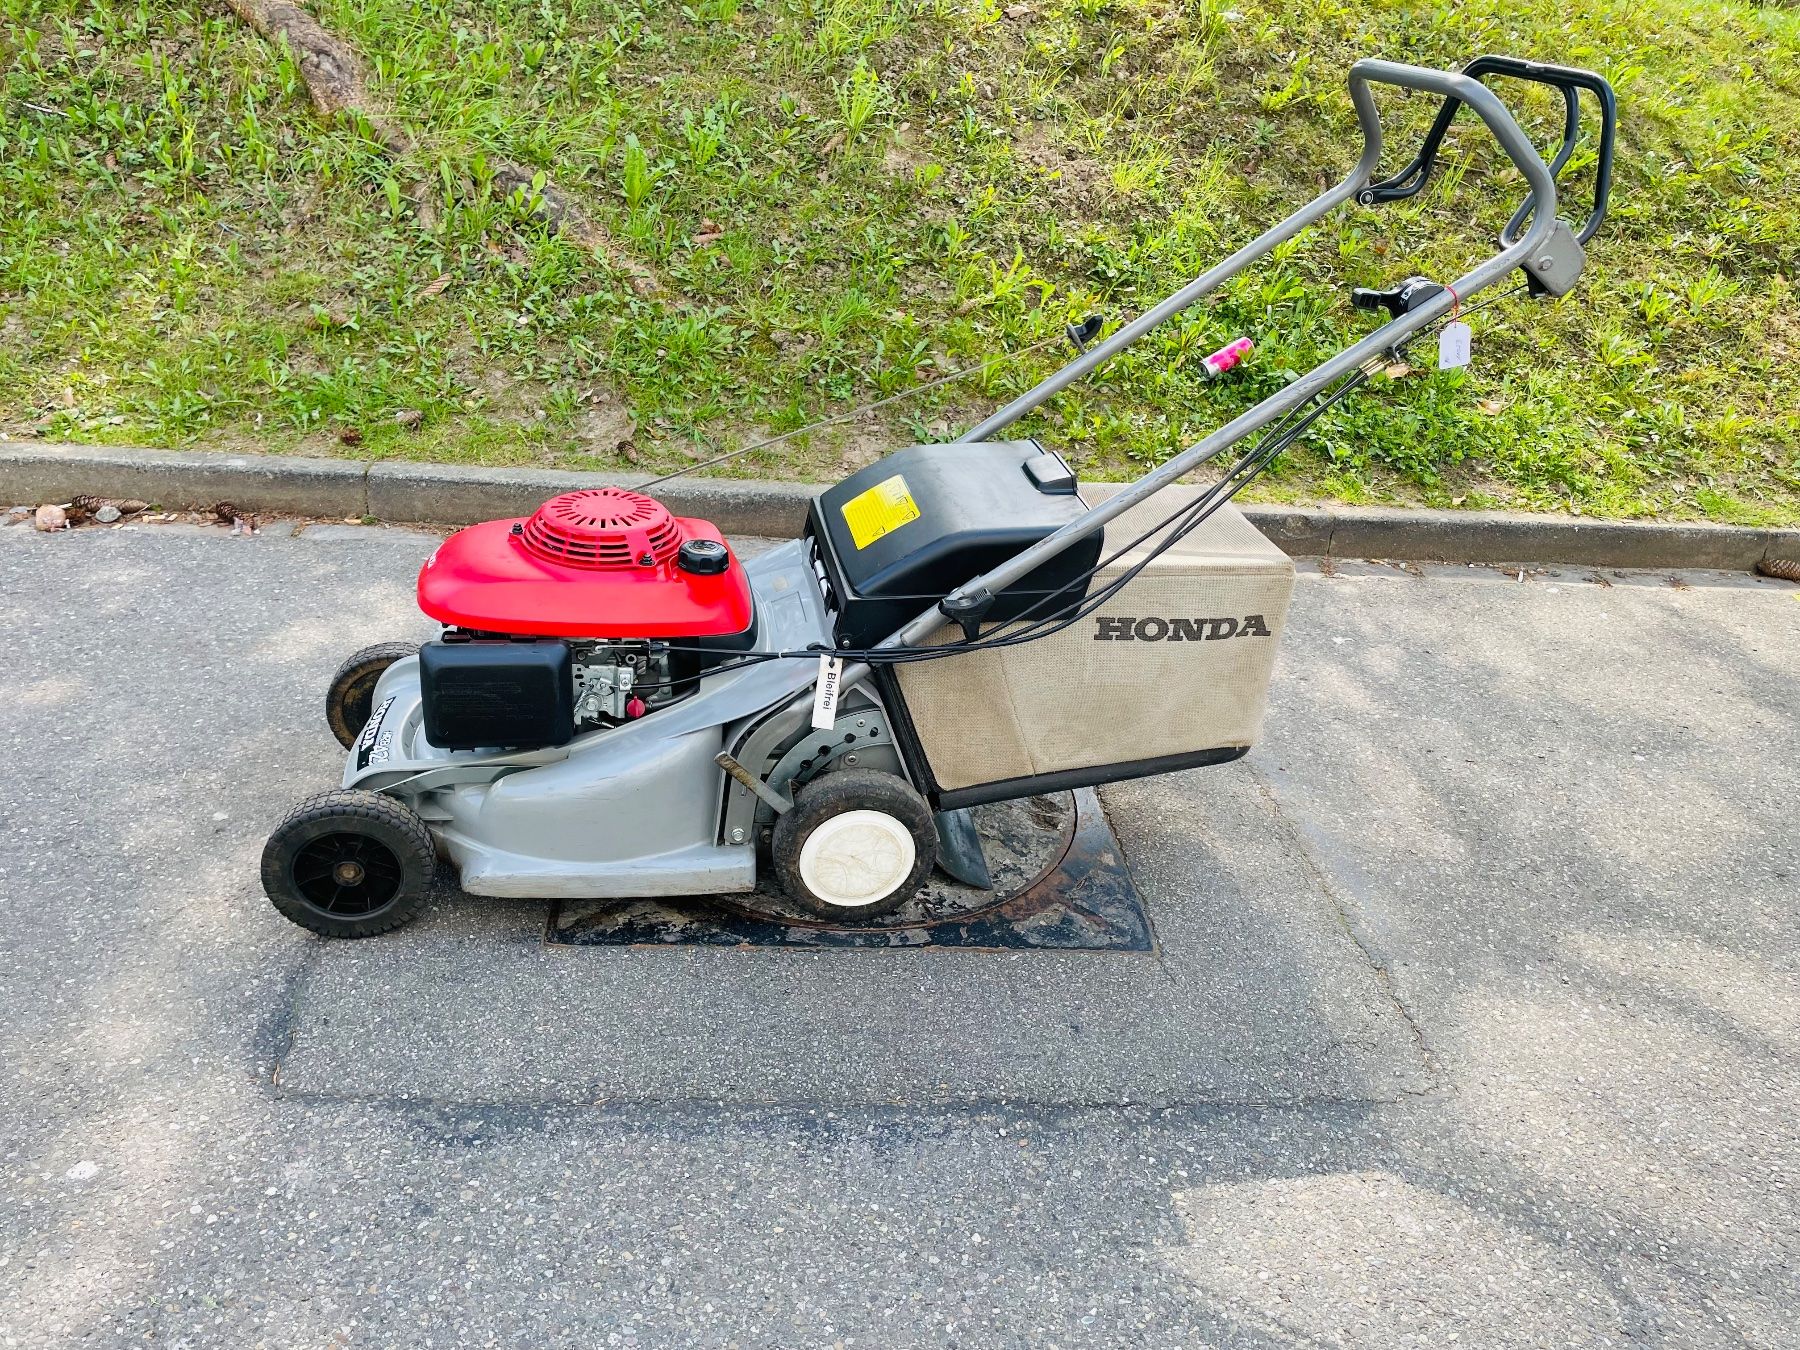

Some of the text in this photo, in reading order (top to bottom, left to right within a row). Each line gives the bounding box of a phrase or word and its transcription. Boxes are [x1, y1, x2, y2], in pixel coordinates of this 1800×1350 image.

[1093, 614, 1272, 643] HONDA
[822, 672, 837, 710] Bleifrei
[360, 698, 394, 752] HONDA
